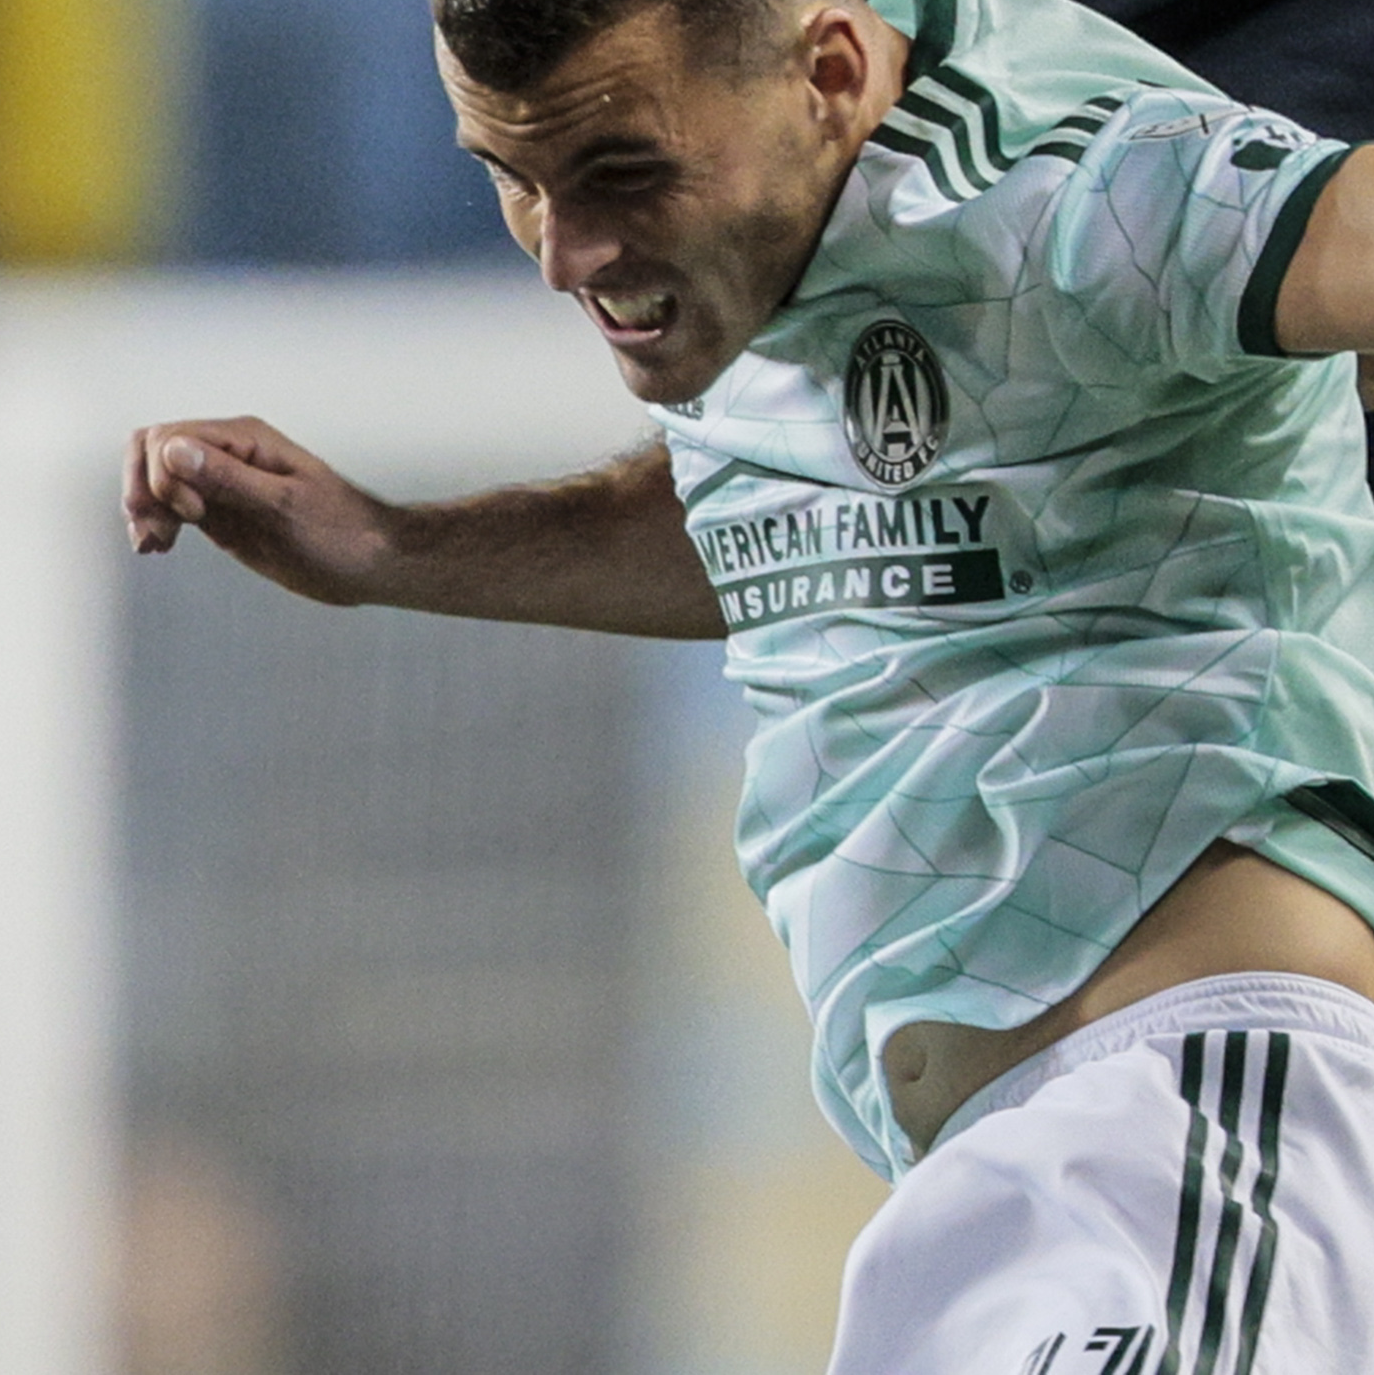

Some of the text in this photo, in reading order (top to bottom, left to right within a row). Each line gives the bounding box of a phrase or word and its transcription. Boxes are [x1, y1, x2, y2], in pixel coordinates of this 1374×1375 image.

[855, 328, 926, 372] ATLANTA
[856, 433, 940, 483] UNITED FC
[835, 495, 991, 552] FAMILY
